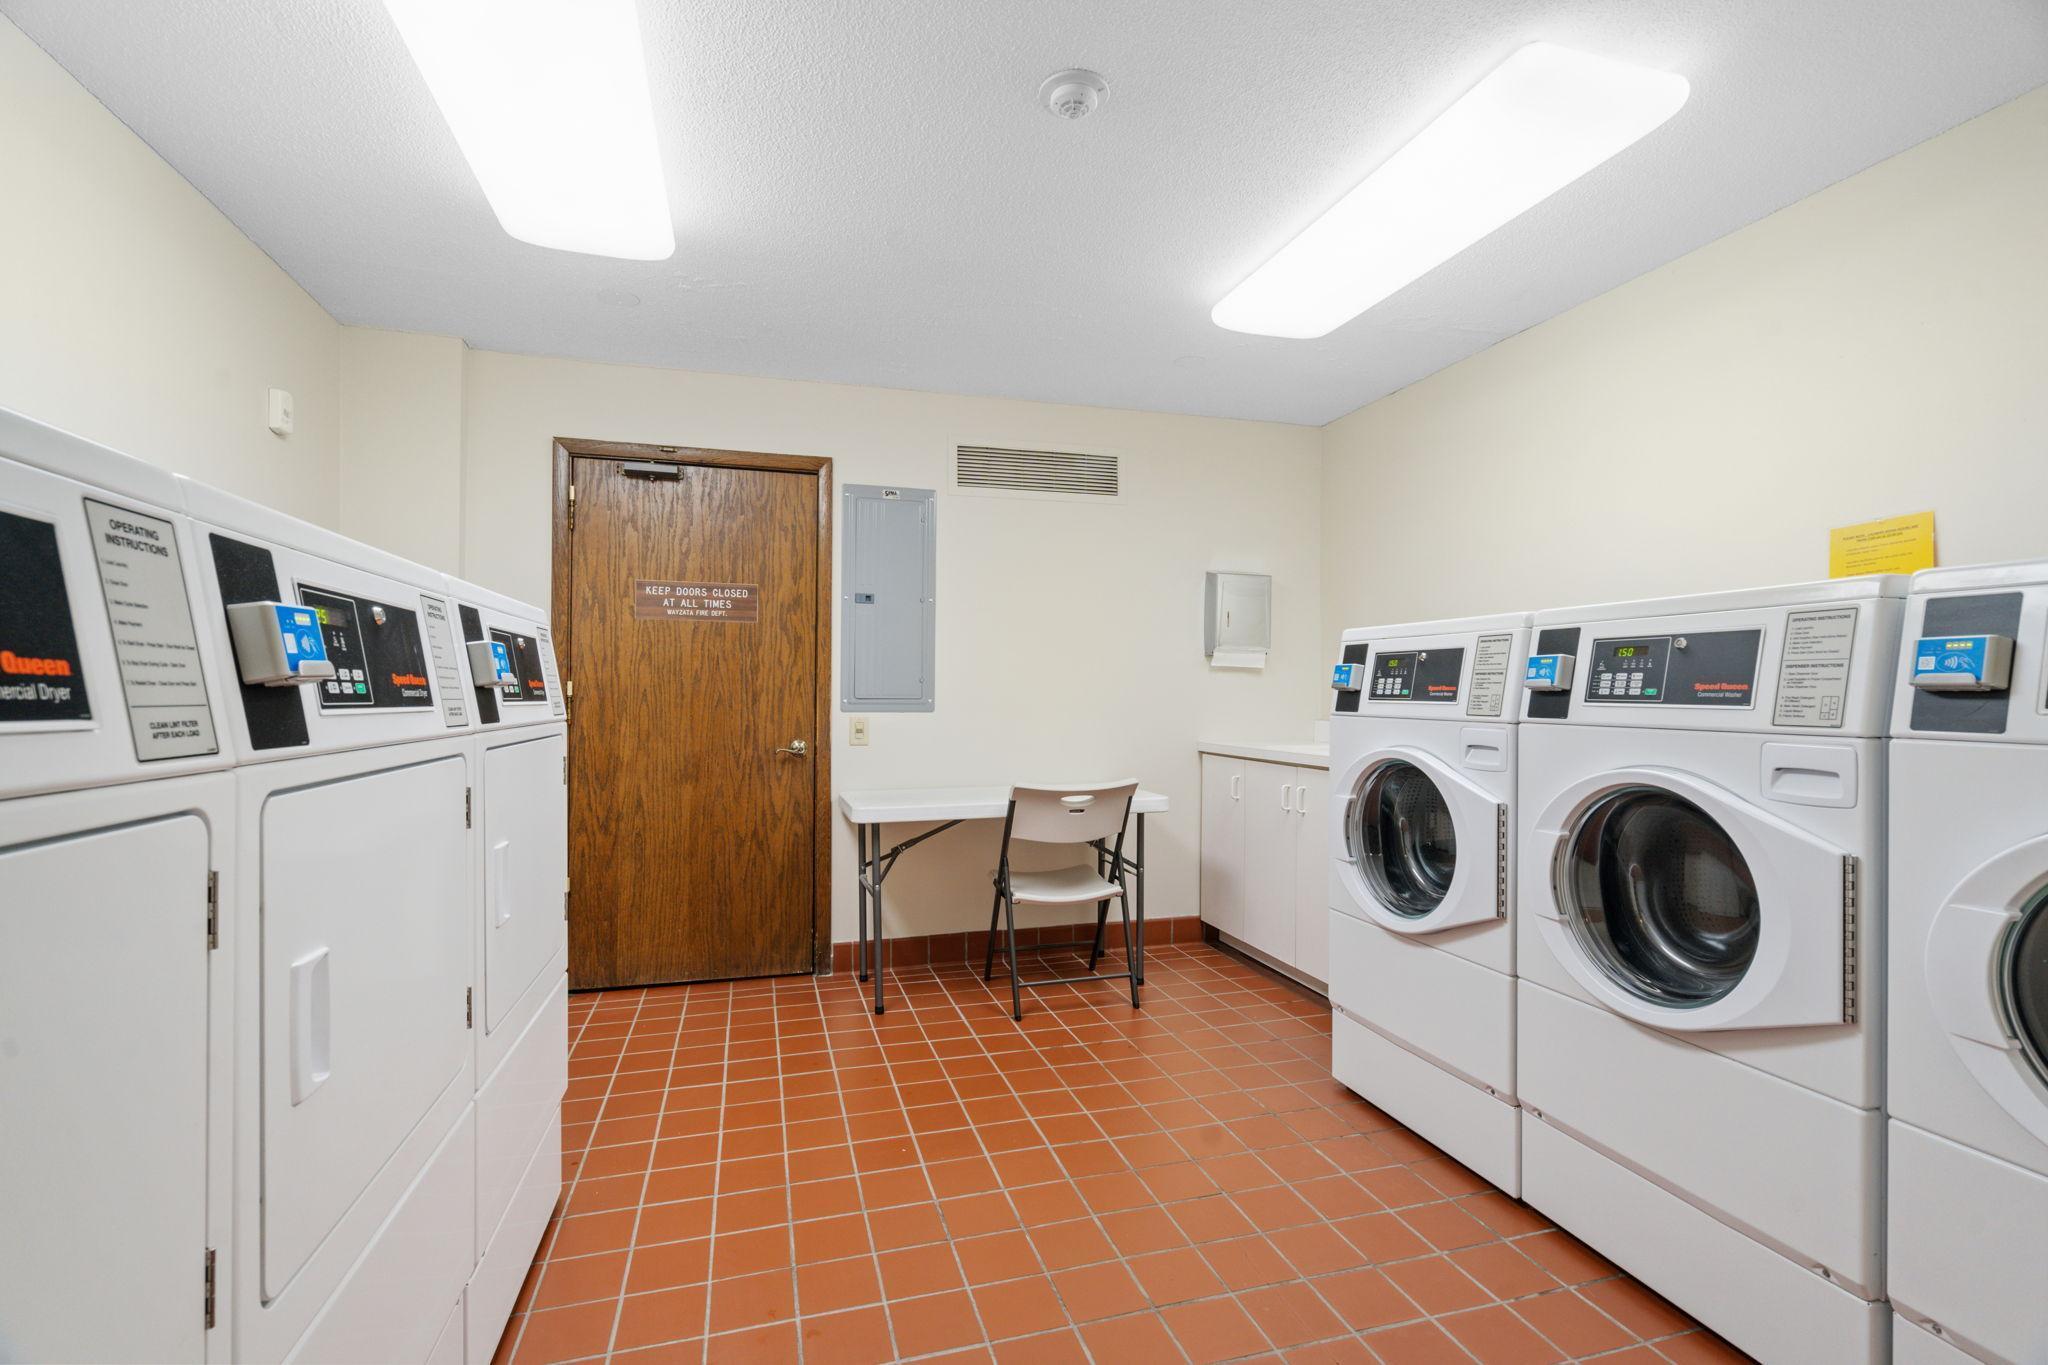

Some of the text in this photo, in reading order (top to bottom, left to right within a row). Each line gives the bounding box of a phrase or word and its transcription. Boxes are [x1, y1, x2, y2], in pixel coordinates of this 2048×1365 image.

[108, 519, 160, 541] OPERATING
[104, 532, 169, 557] INSTRUCTIONS
[645, 586, 748, 598] KEEP DOORS CLOSED
[663, 598, 732, 609] AT ALL TIMES
[696, 609, 709, 617] FIRE
[0, 650, 71, 676] Queen
[1694, 683, 1720, 691] Speed
[0, 683, 71, 703] ercial Dryer
[149, 721, 168, 730] CLEAN
[152, 730, 170, 739] AFTER
